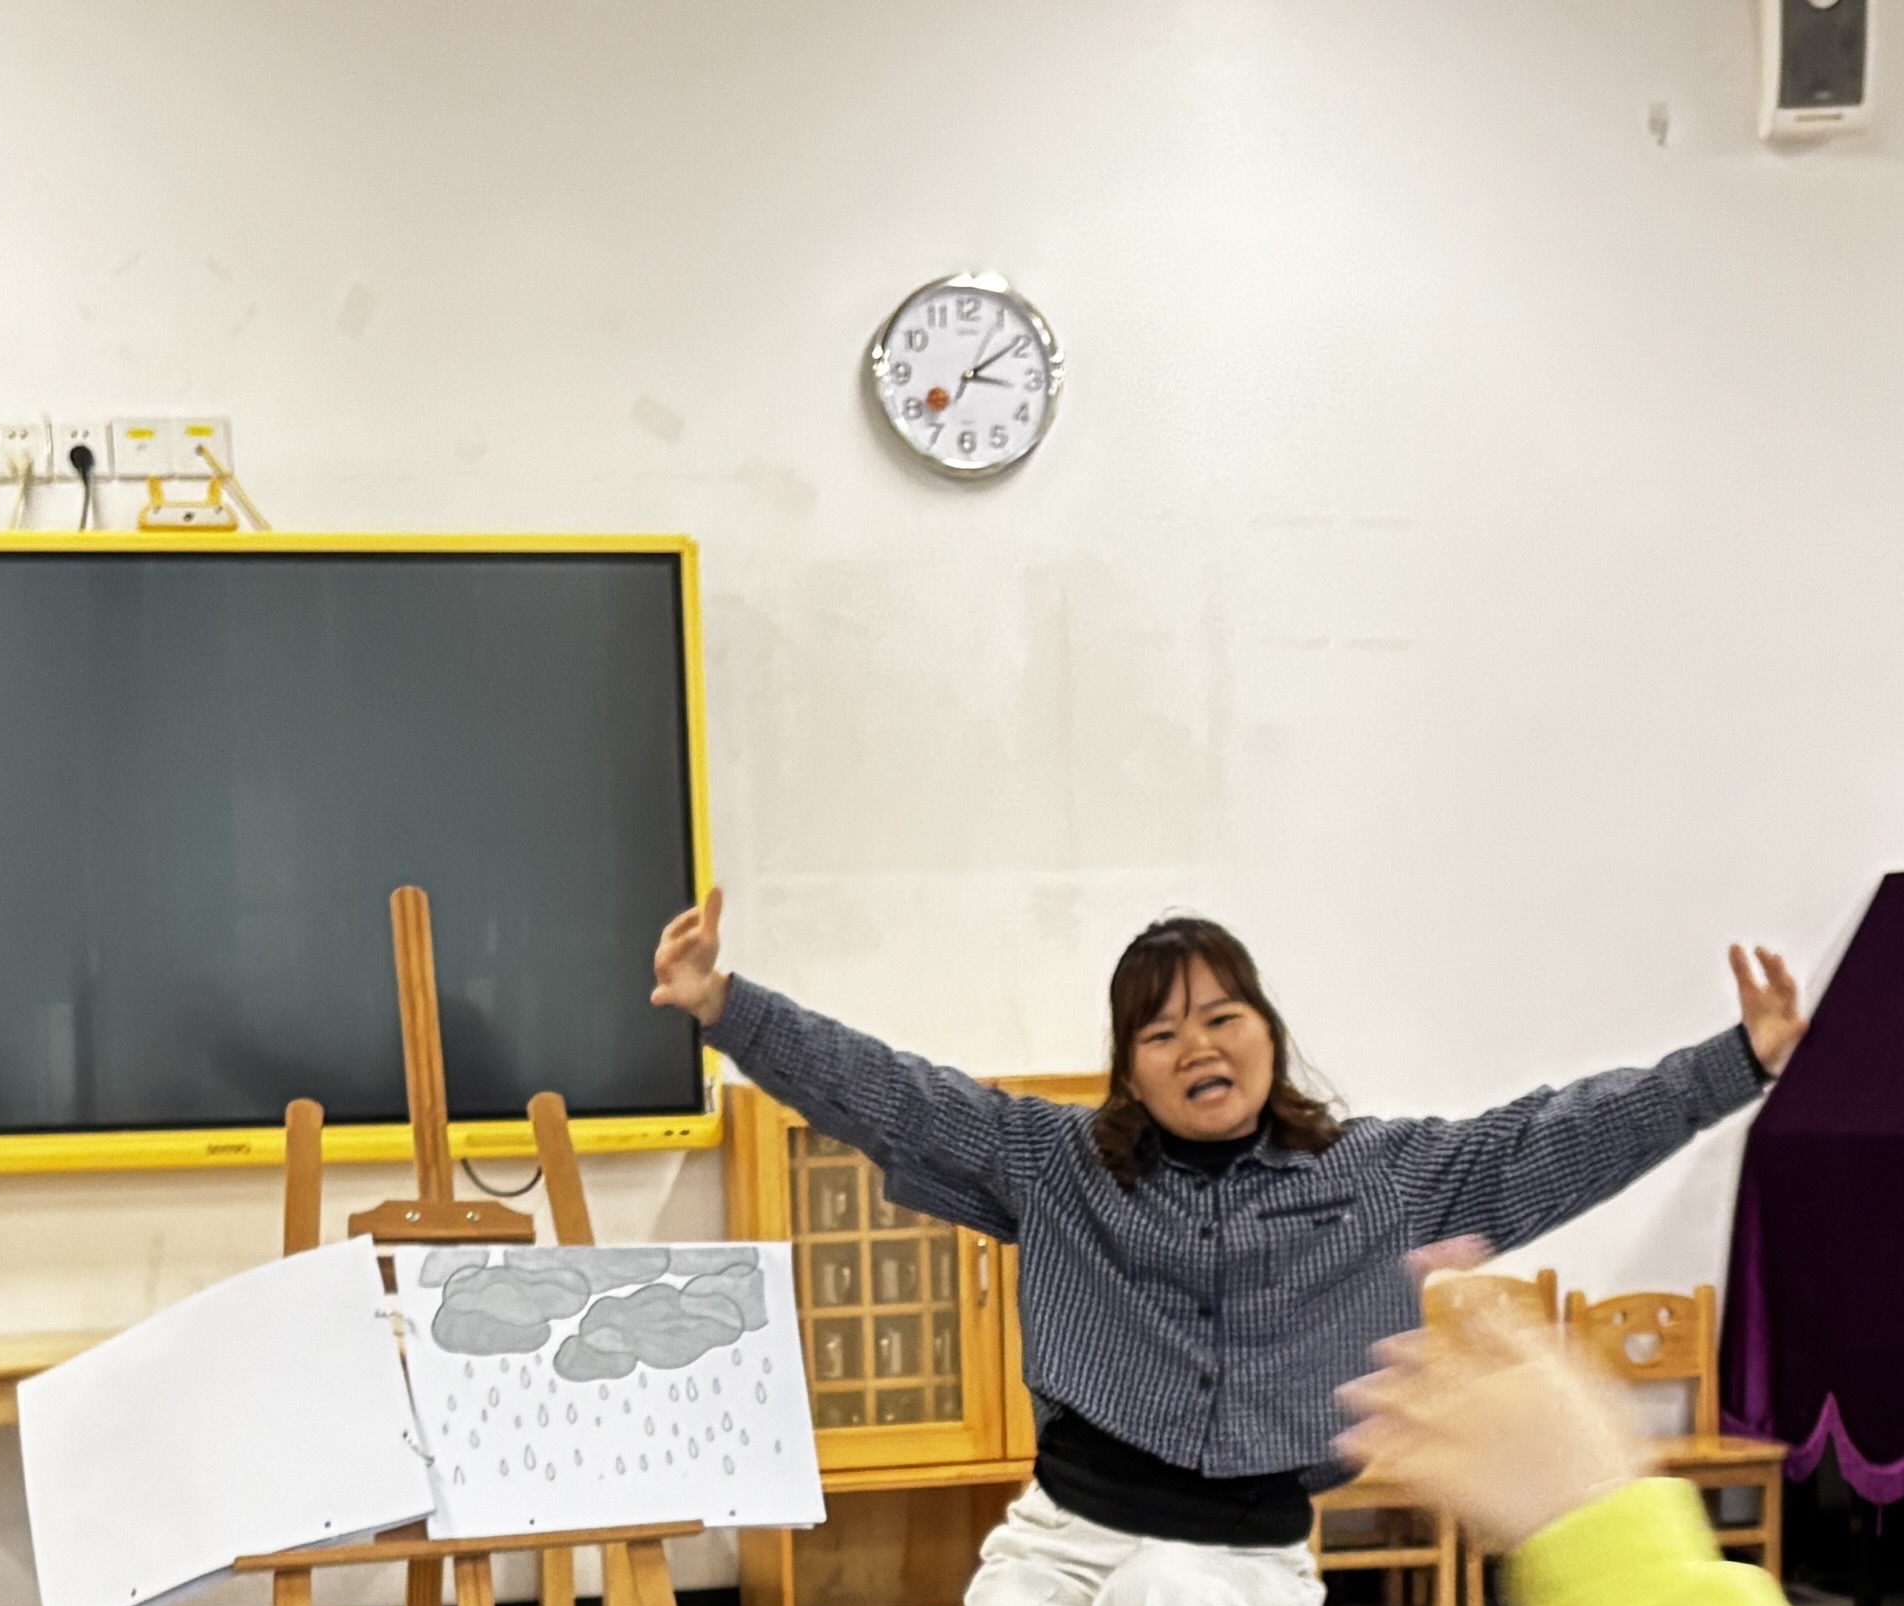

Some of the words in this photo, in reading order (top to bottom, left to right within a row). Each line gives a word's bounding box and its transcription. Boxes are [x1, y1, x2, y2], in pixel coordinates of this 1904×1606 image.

[927, 303, 948, 329] 11
[955, 296, 982, 322] 12
[904, 329, 929, 352] 10
[1011, 333, 1034, 358] 2
[890, 361, 912, 385] 9
[1024, 368, 1044, 392] 3
[902, 397, 923, 420] 8
[1013, 400, 1030, 425] 4
[929, 422, 944, 450] 7
[956, 430, 977, 454] 6
[988, 425, 1010, 449] 5
